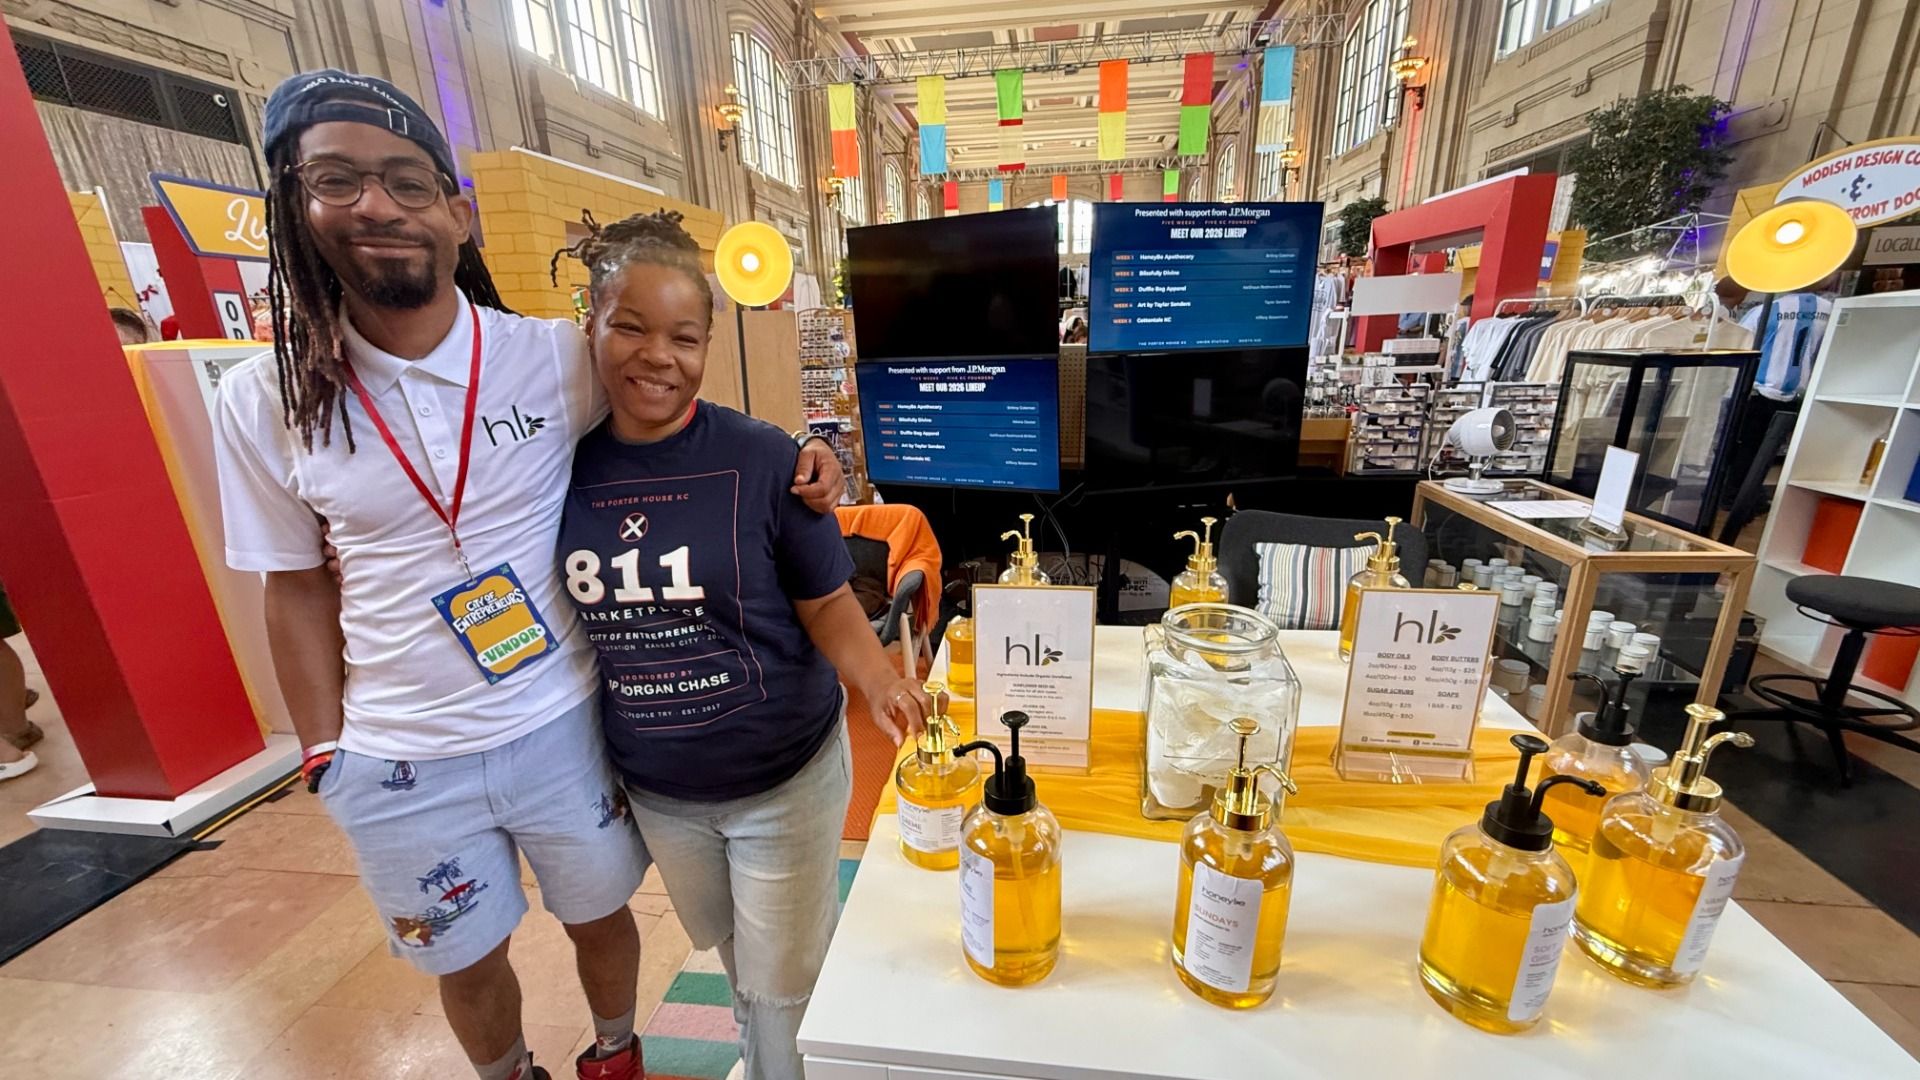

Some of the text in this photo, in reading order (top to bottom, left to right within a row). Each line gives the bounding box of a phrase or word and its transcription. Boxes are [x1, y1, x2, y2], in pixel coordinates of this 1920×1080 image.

[1803, 157, 1852, 188] MODISH
[1854, 150, 1904, 169] DESIGN
[1135, 208, 1168, 217] Presented
[1169, 208, 1183, 217] with
[1184, 208, 1210, 218] support
[1211, 208, 1227, 216] from
[1170, 228, 1189, 239] MEET
[1190, 228, 1204, 238] OUR
[1224, 227, 1247, 238] LINEUP
[916, 366, 928, 374] with
[928, 367, 951, 375] support
[919, 383, 935, 392] MEET
[936, 383, 948, 392] OUR
[966, 383, 986, 392] LINEUP
[608, 497, 639, 507] PORTER
[642, 494, 673, 503] HOUSE
[565, 545, 705, 605] 811
[466, 591, 497, 611] CITY OF
[452, 588, 526, 634] ENTREPRENEURS
[589, 633, 607, 641] CITY
[609, 633, 621, 641] OF
[679, 637, 699, 647] CITY
[483, 627, 540, 662] VENDOR
[1450, 655, 1479, 663] BUTTERS
[620, 672, 676, 681] SPONSORED
[678, 672, 730, 693] CHASE
[1390, 688, 1414, 696] SCRUBS
[1194, 903, 1239, 928] SUNDAYS
